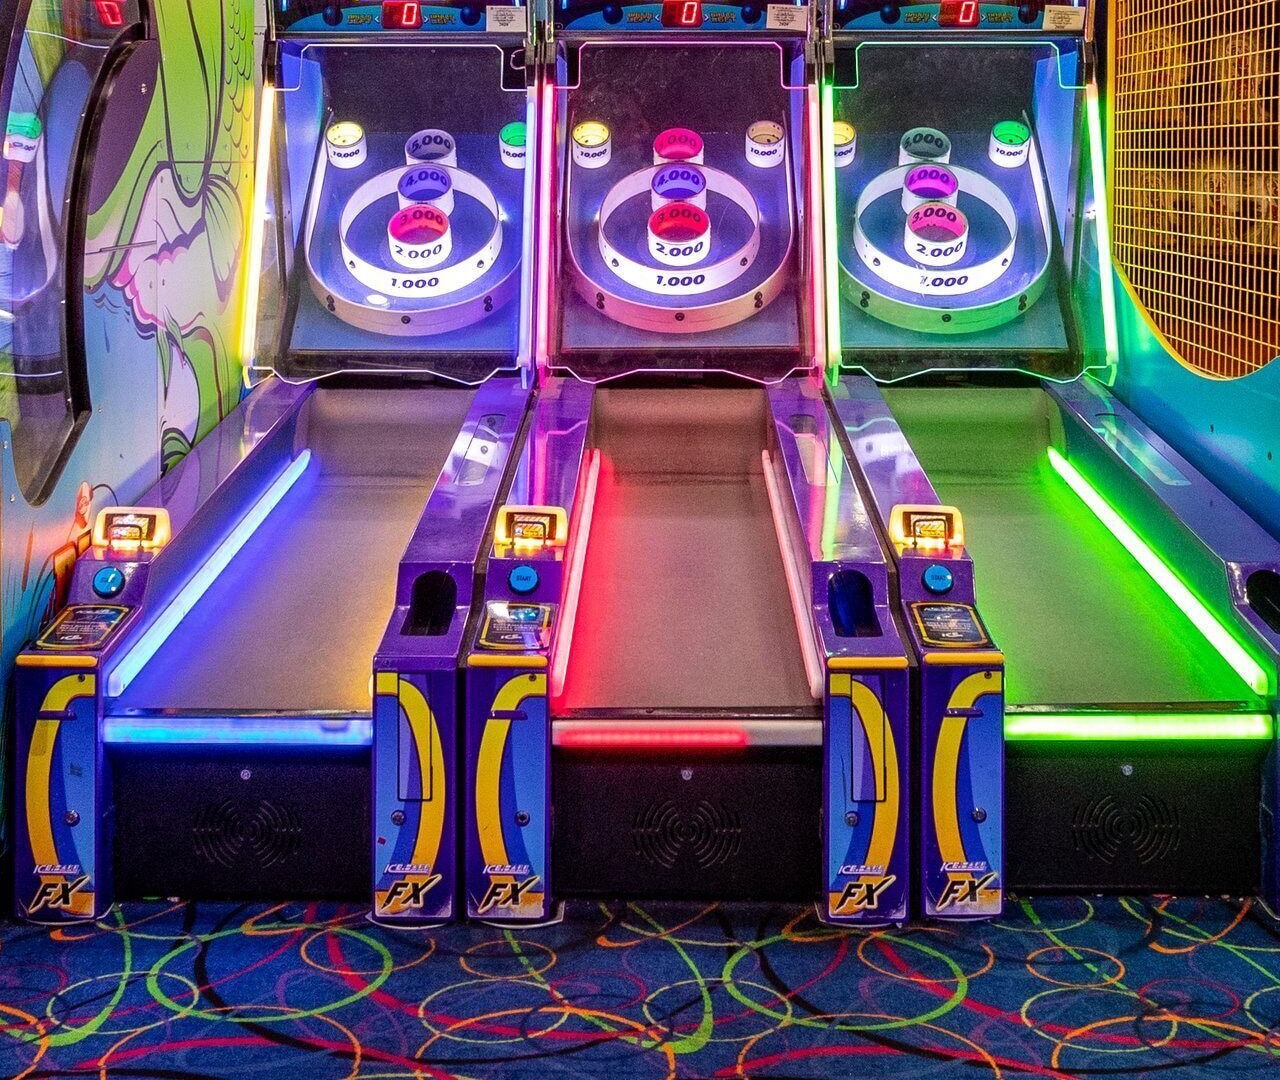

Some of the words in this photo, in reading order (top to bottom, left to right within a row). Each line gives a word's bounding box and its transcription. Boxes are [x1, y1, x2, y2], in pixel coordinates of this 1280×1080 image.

[402, 2, 418, 25] 0
[681, 1, 698, 24] 0
[958, 1, 976, 24] 0
[516, 574, 532, 582] START
[29, 876, 90, 912] FX
[380, 874, 442, 911] FX
[479, 875, 540, 912] FX
[834, 875, 897, 914] FX
[936, 872, 998, 911] FX
